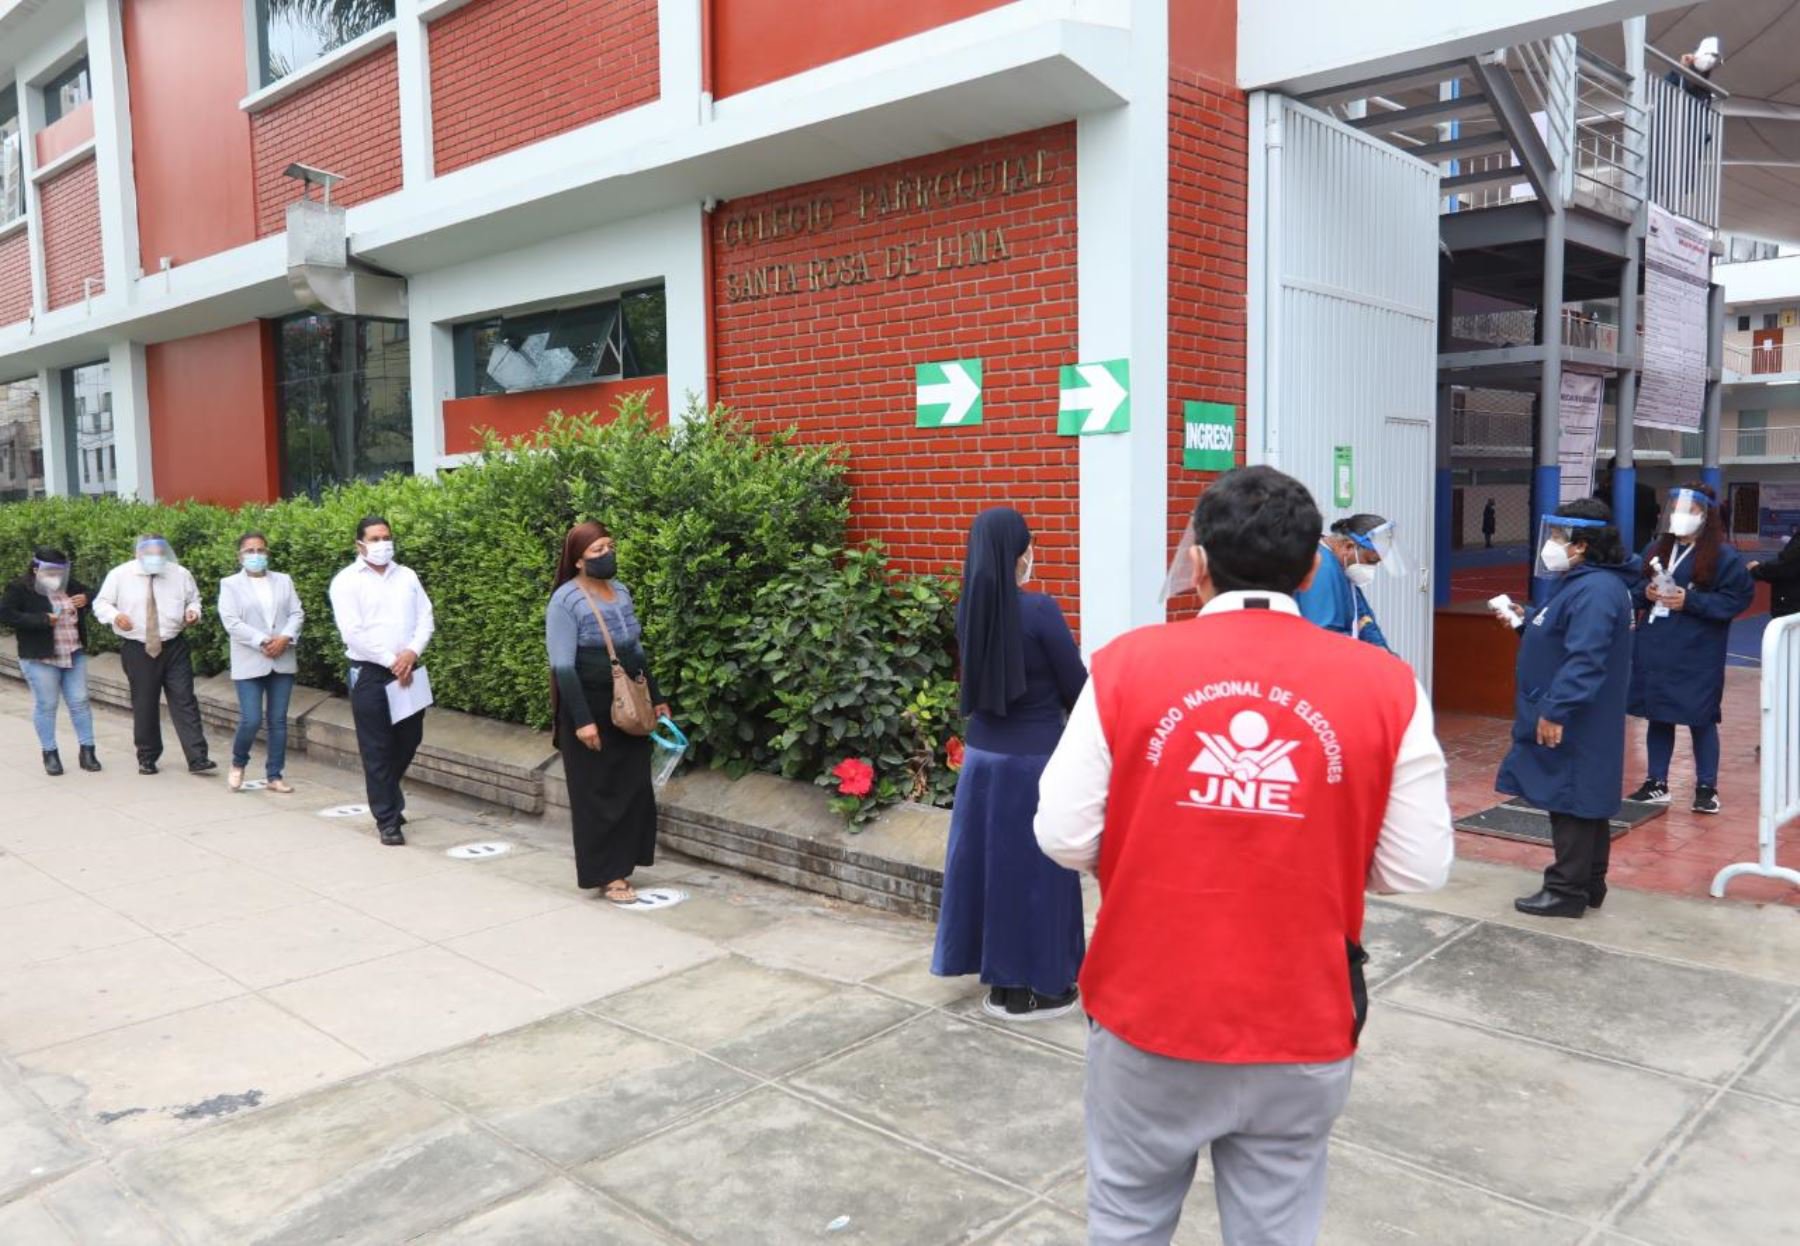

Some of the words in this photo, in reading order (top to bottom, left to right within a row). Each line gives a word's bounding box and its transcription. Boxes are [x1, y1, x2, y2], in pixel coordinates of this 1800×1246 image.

[725, 264, 798, 302] SANTA
[808, 251, 873, 292] ROSA
[885, 242, 920, 278] DE
[936, 227, 1010, 269] LIMA
[1186, 422, 1233, 451] INGRESO
[1147, 707, 1183, 766] JURADO
[1184, 681, 1262, 709] NACIONAL
[1269, 686, 1292, 706] DE
[1294, 701, 1342, 784] ELECCIONES
[1189, 778, 1292, 811] JNE
